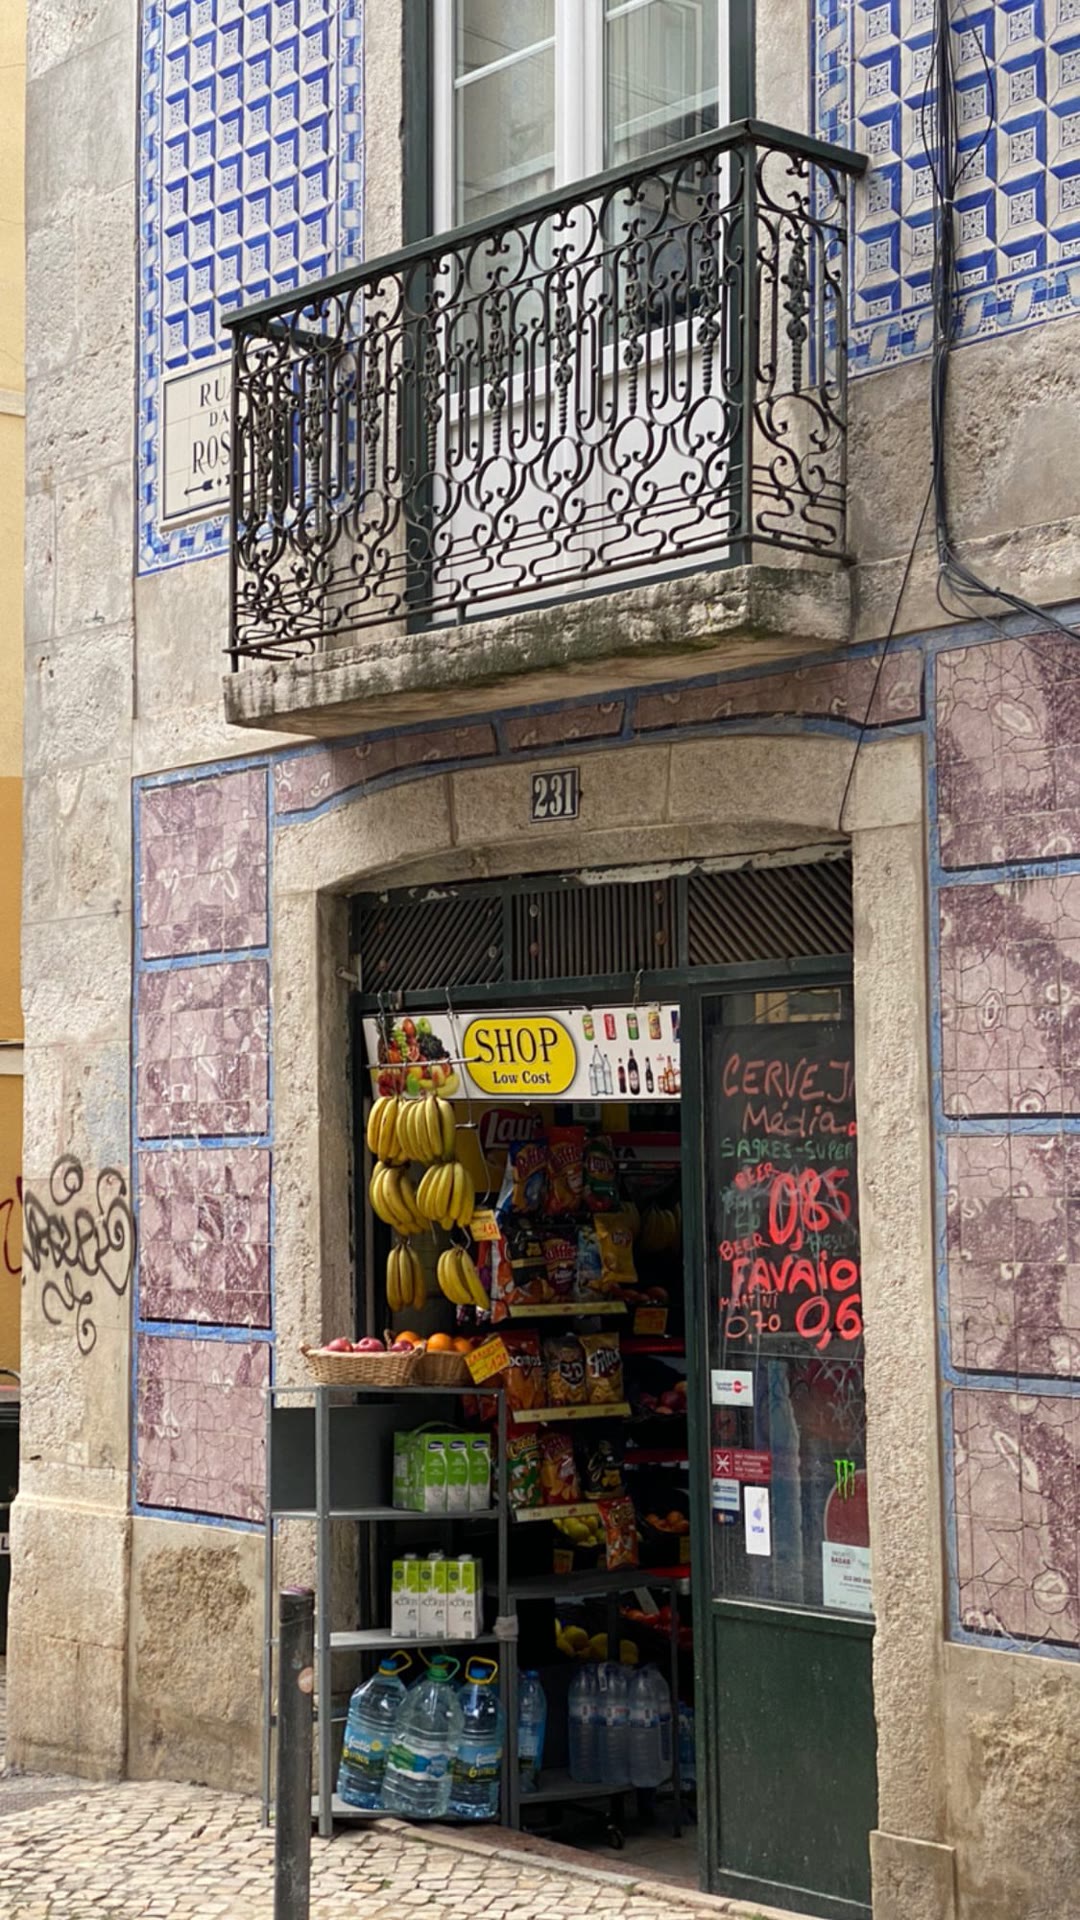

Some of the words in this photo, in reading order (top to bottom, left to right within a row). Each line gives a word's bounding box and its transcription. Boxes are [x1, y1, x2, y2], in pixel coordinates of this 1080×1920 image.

[200, 376, 231, 407] RU
[210, 409, 229, 427] DA
[193, 430, 236, 475] ROS
[534, 773, 573, 817] 231
[475, 1027, 558, 1063] SHOP
[492, 1070, 518, 1084] Low
[522, 1070, 551, 1084] Cost
[722, 1053, 855, 1103] CERVEJ
[719, 1232, 771, 1261] BEER
